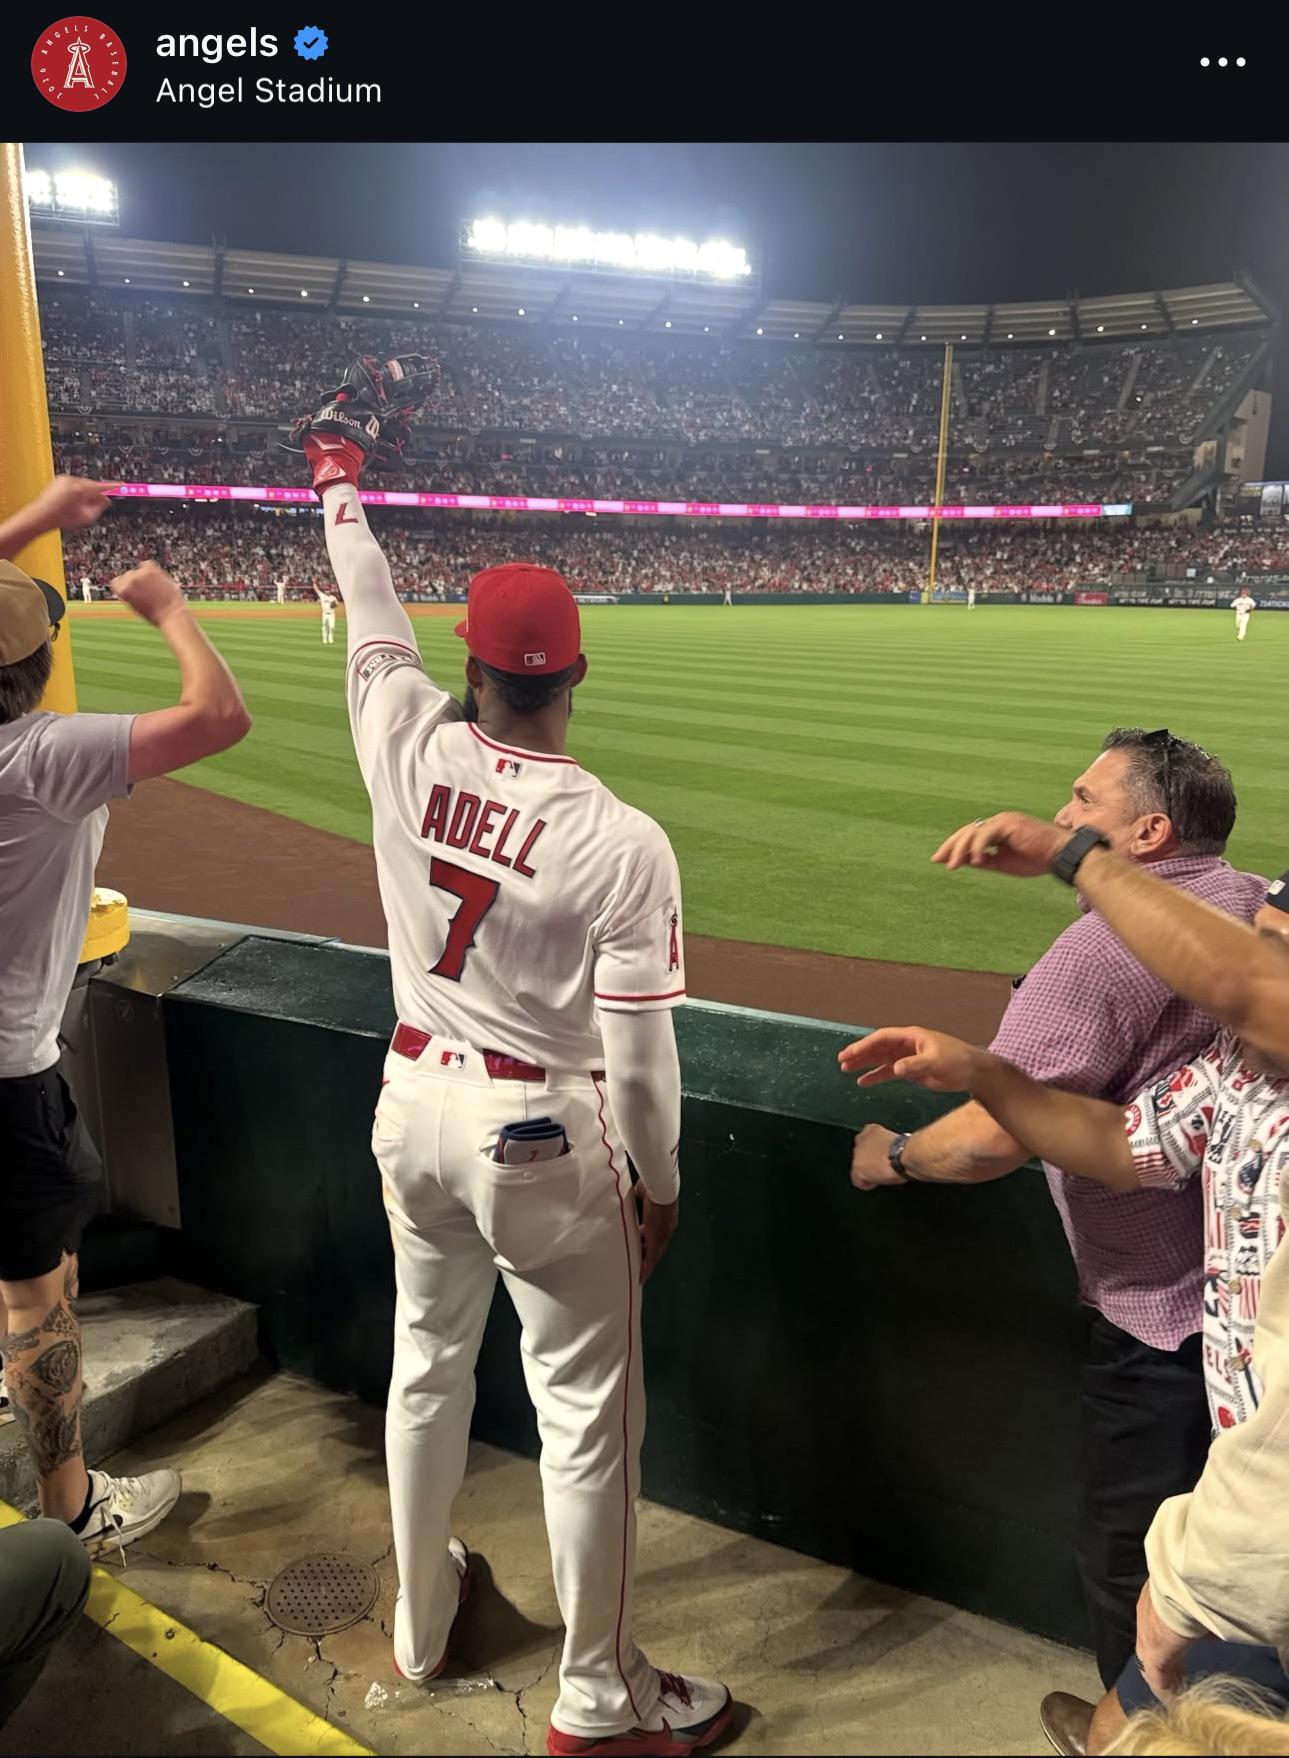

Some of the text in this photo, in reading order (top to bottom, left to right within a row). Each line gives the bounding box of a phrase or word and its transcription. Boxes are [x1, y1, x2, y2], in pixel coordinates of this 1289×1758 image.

[321, 409, 361, 428] Wilson
[420, 783, 547, 879] ADELL
[427, 856, 501, 984] 7
